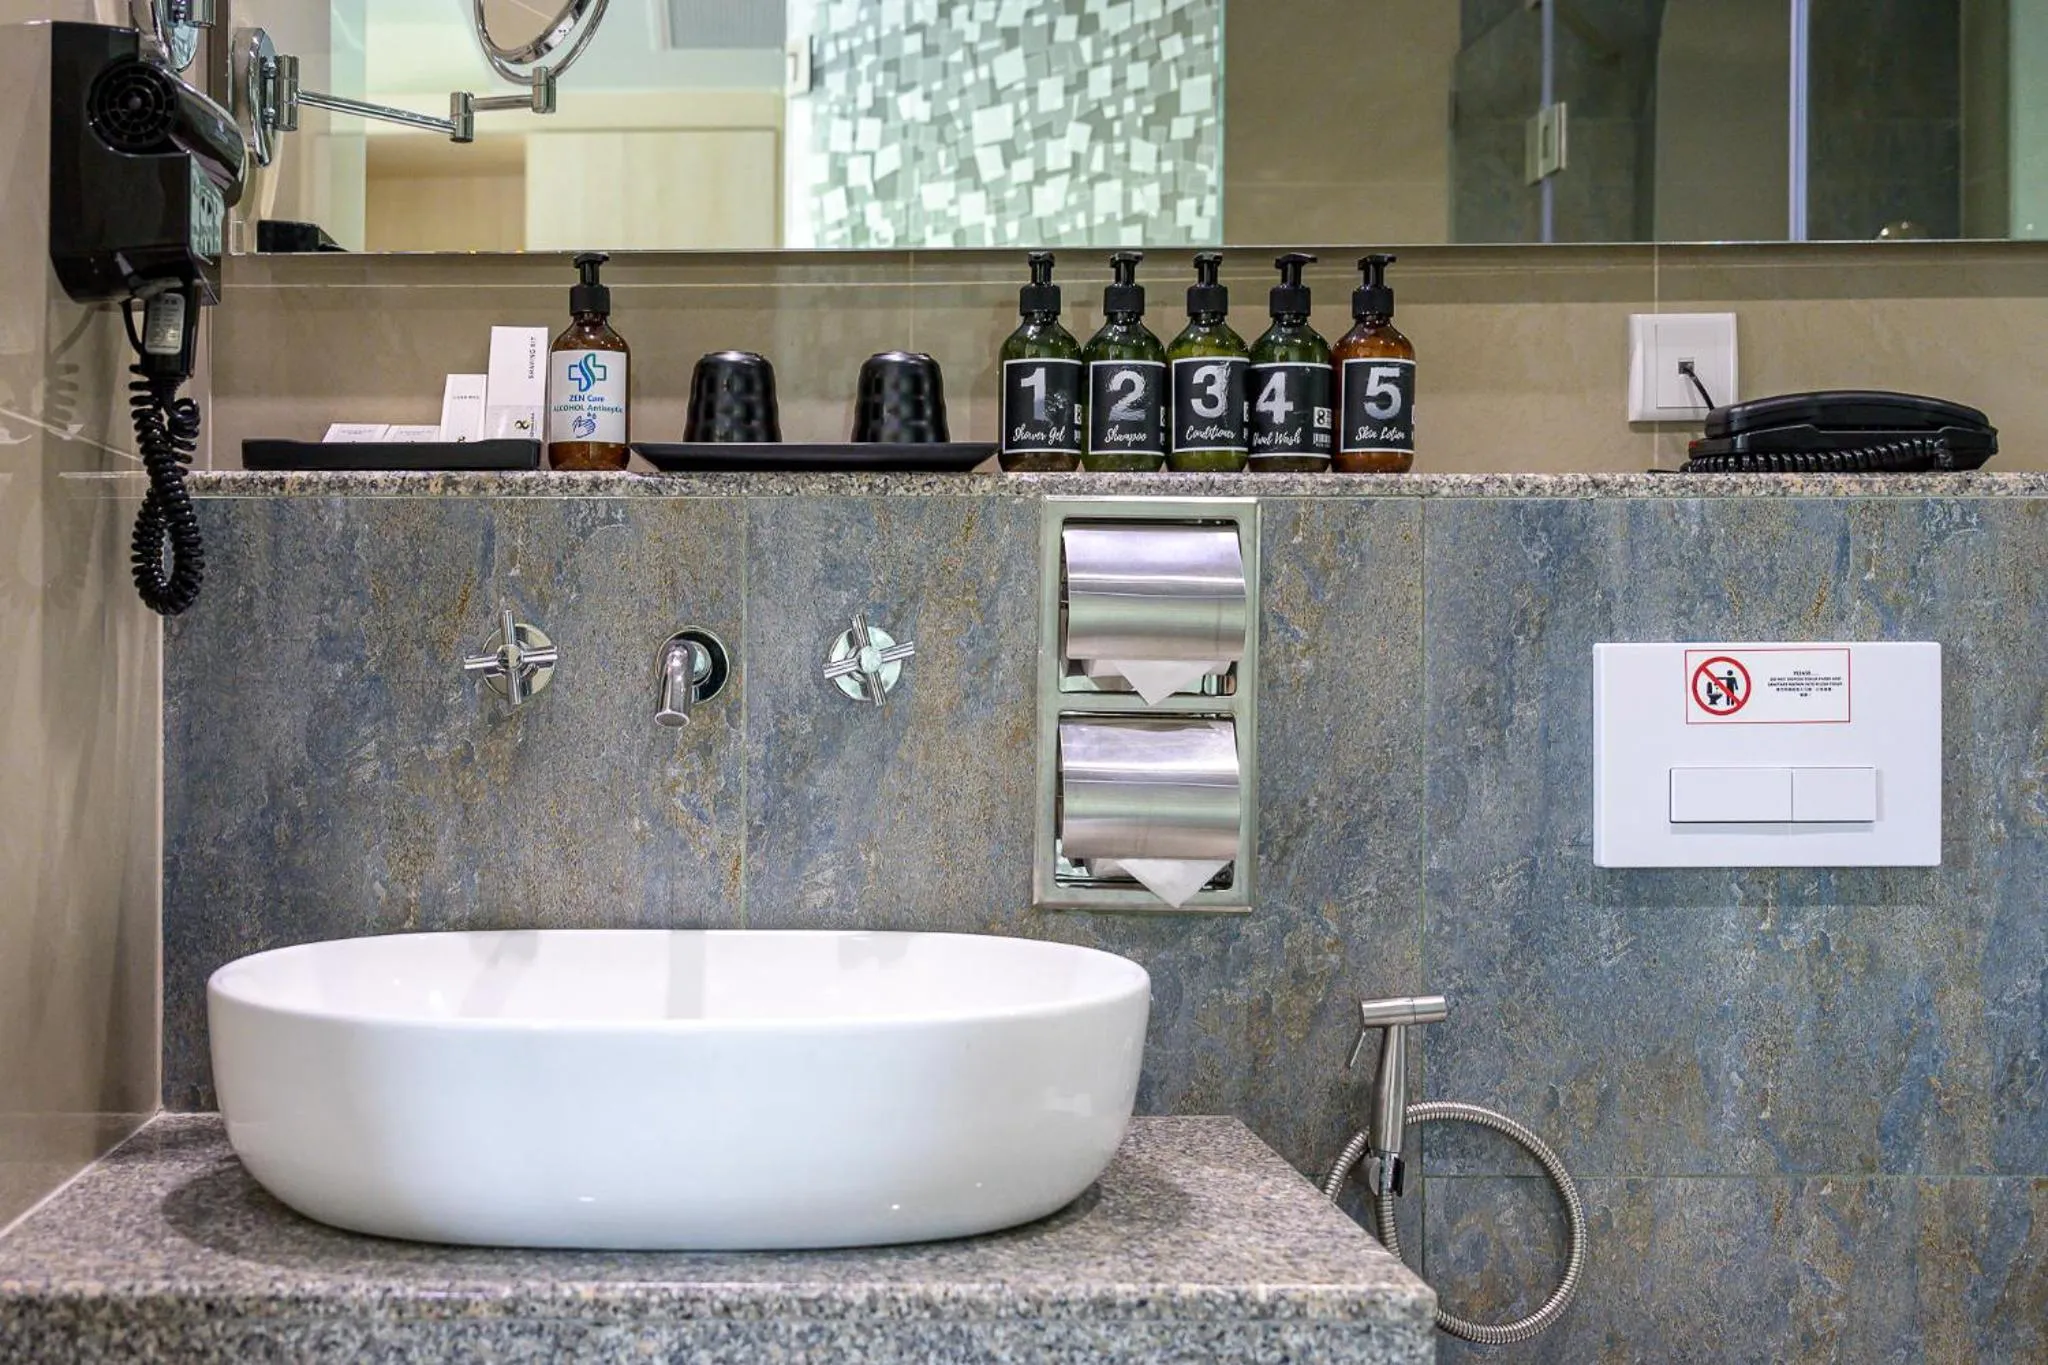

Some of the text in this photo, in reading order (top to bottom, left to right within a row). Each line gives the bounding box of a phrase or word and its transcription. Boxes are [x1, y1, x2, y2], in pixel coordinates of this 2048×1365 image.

[568, 394, 605, 402] ZEN Care
[1020, 367, 1046, 420] 1
[1109, 370, 1146, 421] 2
[1191, 365, 1228, 418] 3
[1255, 371, 1294, 424] 4
[1363, 367, 1402, 420] 5
[1013, 423, 1066, 445] Shower Gel
[1355, 425, 1378, 441] Skin
